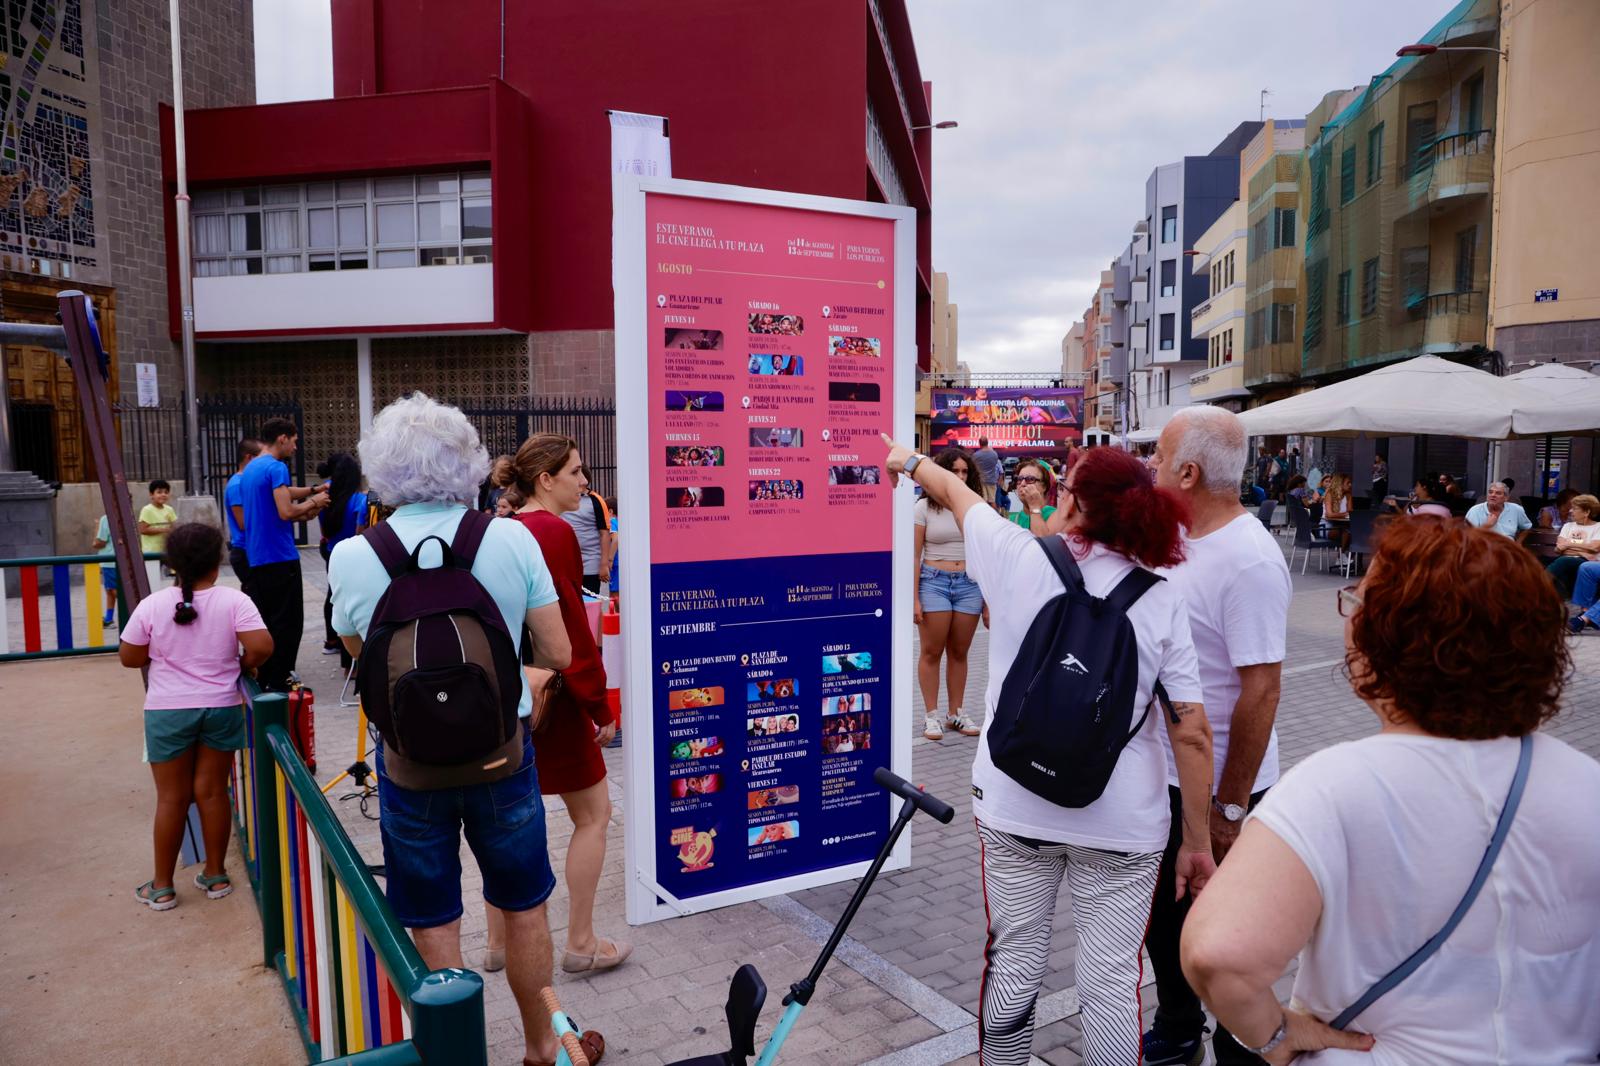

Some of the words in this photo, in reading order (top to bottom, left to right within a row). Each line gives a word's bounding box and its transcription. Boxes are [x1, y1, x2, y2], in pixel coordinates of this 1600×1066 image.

[656, 223, 677, 233] ESTE
[656, 234, 667, 244] EL
[669, 235, 688, 246] CINE
[690, 237, 716, 248] LLEGA
[718, 240, 724, 249] A
[726, 240, 736, 250] TU
[738, 241, 764, 252] PLAZA
[797, 238, 804, 246] 14
[788, 246, 796, 255] 13
[804, 250, 834, 258] SEPTIEMBRE
[862, 246, 880, 254] TODOS
[656, 263, 692, 275] AGOSTO
[748, 300, 771, 309] SÁBADO
[854, 307, 884, 315] BERTHELOT
[664, 315, 687, 324] JUEVES
[828, 324, 850, 332] SÁBADO
[983, 407, 1031, 422] SABINO
[970, 425, 1044, 439] BERTHELOT
[796, 585, 804, 593] 14
[857, 589, 882, 598] PÚBLICOS
[661, 592, 680, 601] ESTE
[661, 602, 671, 612] EL
[672, 601, 692, 612] CINE
[694, 600, 718, 610] LLEGA
[720, 599, 725, 608] A
[727, 598, 737, 607] TU
[739, 596, 764, 606] PLAZA
[660, 622, 716, 636] SEPTIEMBRE
[822, 644, 843, 652] SÁBADO
[673, 658, 692, 667] PLAZA
[715, 655, 736, 663] BENITO
[763, 656, 788, 665] LORENZO
[747, 670, 768, 678] SÁBADO
[668, 678, 690, 688] JUEVES
[669, 728, 694, 737] VIERNES
[752, 755, 772, 763] PARQUE
[785, 750, 807, 759] ESTADIO
[752, 761, 775, 770] INSULAR
[1031, 761, 1046, 772] SIERRA
[748, 780, 770, 789] VIERNES
